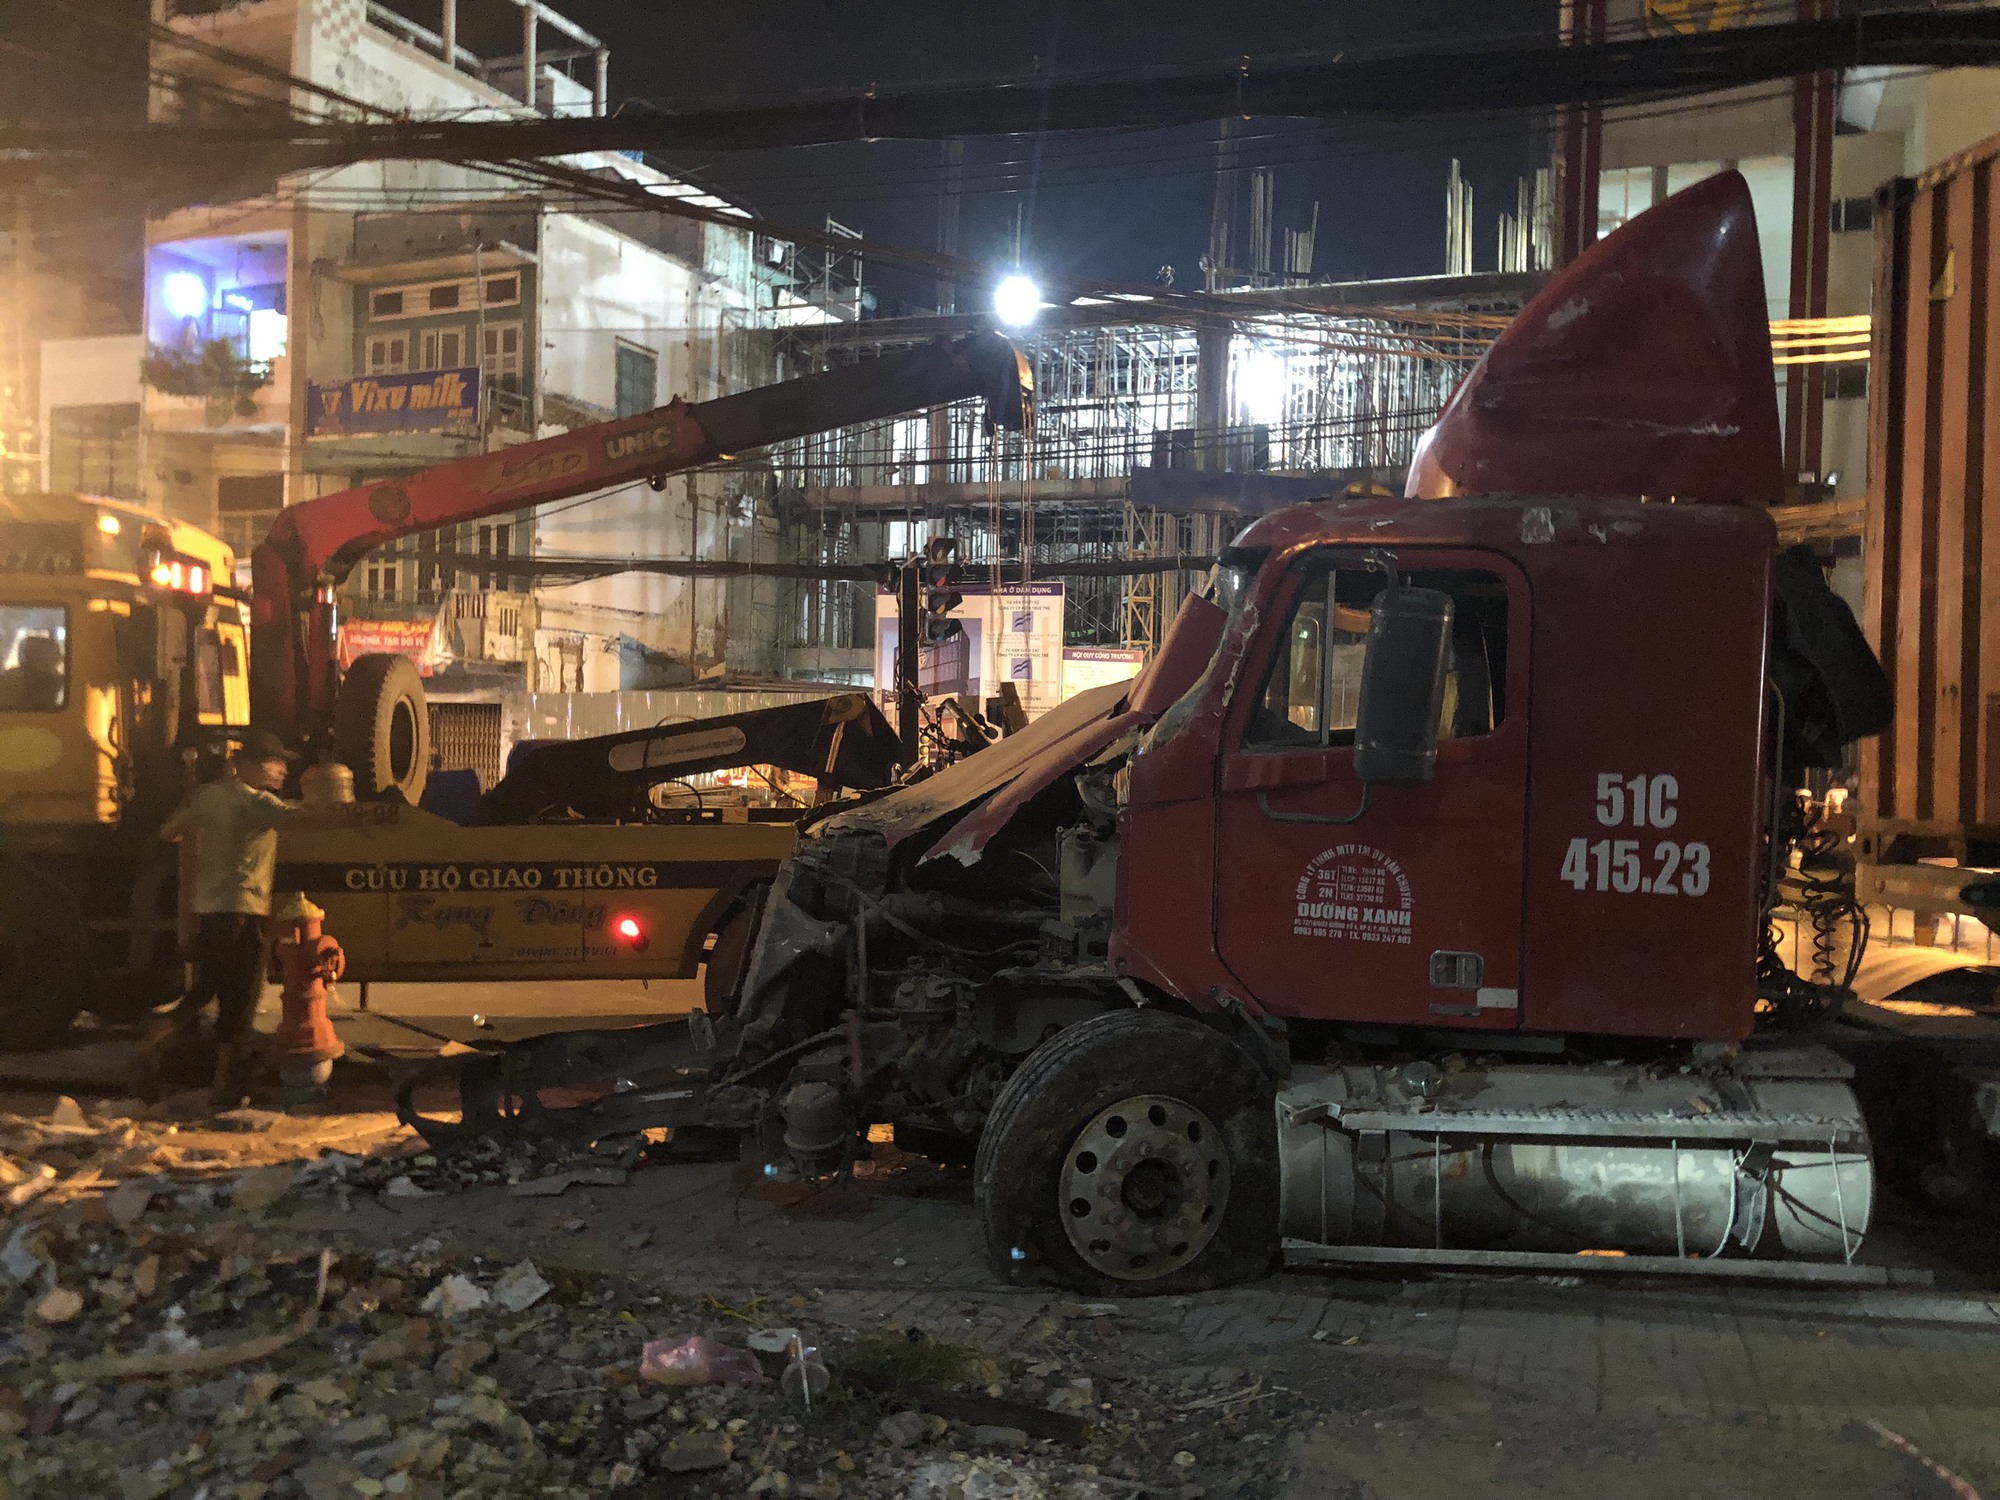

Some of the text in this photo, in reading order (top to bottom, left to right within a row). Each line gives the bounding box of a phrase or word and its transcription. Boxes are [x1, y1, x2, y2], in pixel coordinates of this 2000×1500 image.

[1596, 772, 1679, 829] 51C
[1311, 848, 1336, 867] TNHH
[1336, 844, 1355, 856] MTV
[1560, 837, 1712, 897] 415.23
[418, 864, 462, 893] HỘ
[470, 867, 543, 890] GIAO
[553, 863, 659, 889] THÔNG
[1318, 887, 1333, 898] 2N
[1363, 907, 1412, 926] XANH
